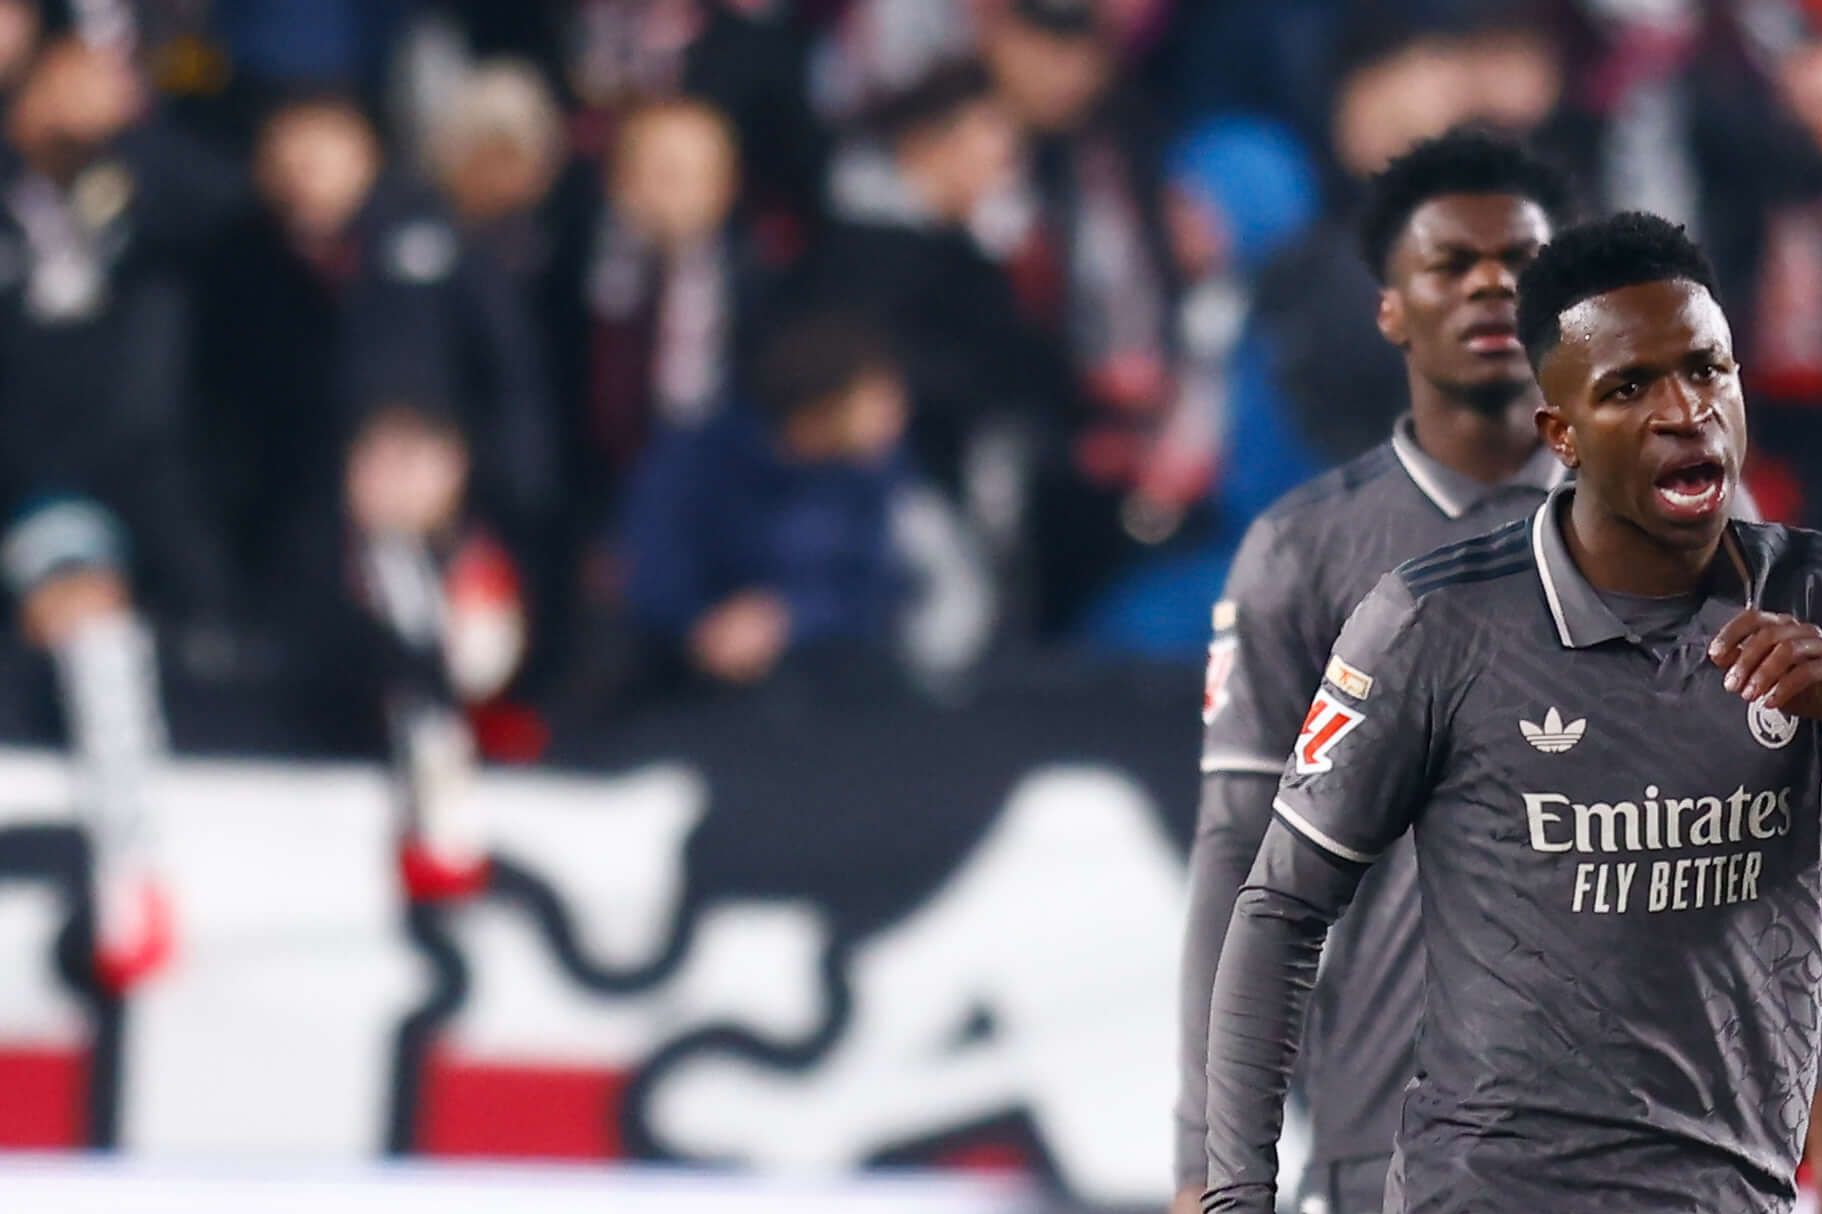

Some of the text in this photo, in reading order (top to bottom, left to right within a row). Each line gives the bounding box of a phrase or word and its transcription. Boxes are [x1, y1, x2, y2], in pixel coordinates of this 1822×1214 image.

[1522, 784, 1792, 852] Emirates
[1571, 851, 1762, 913] FLY BETTER
